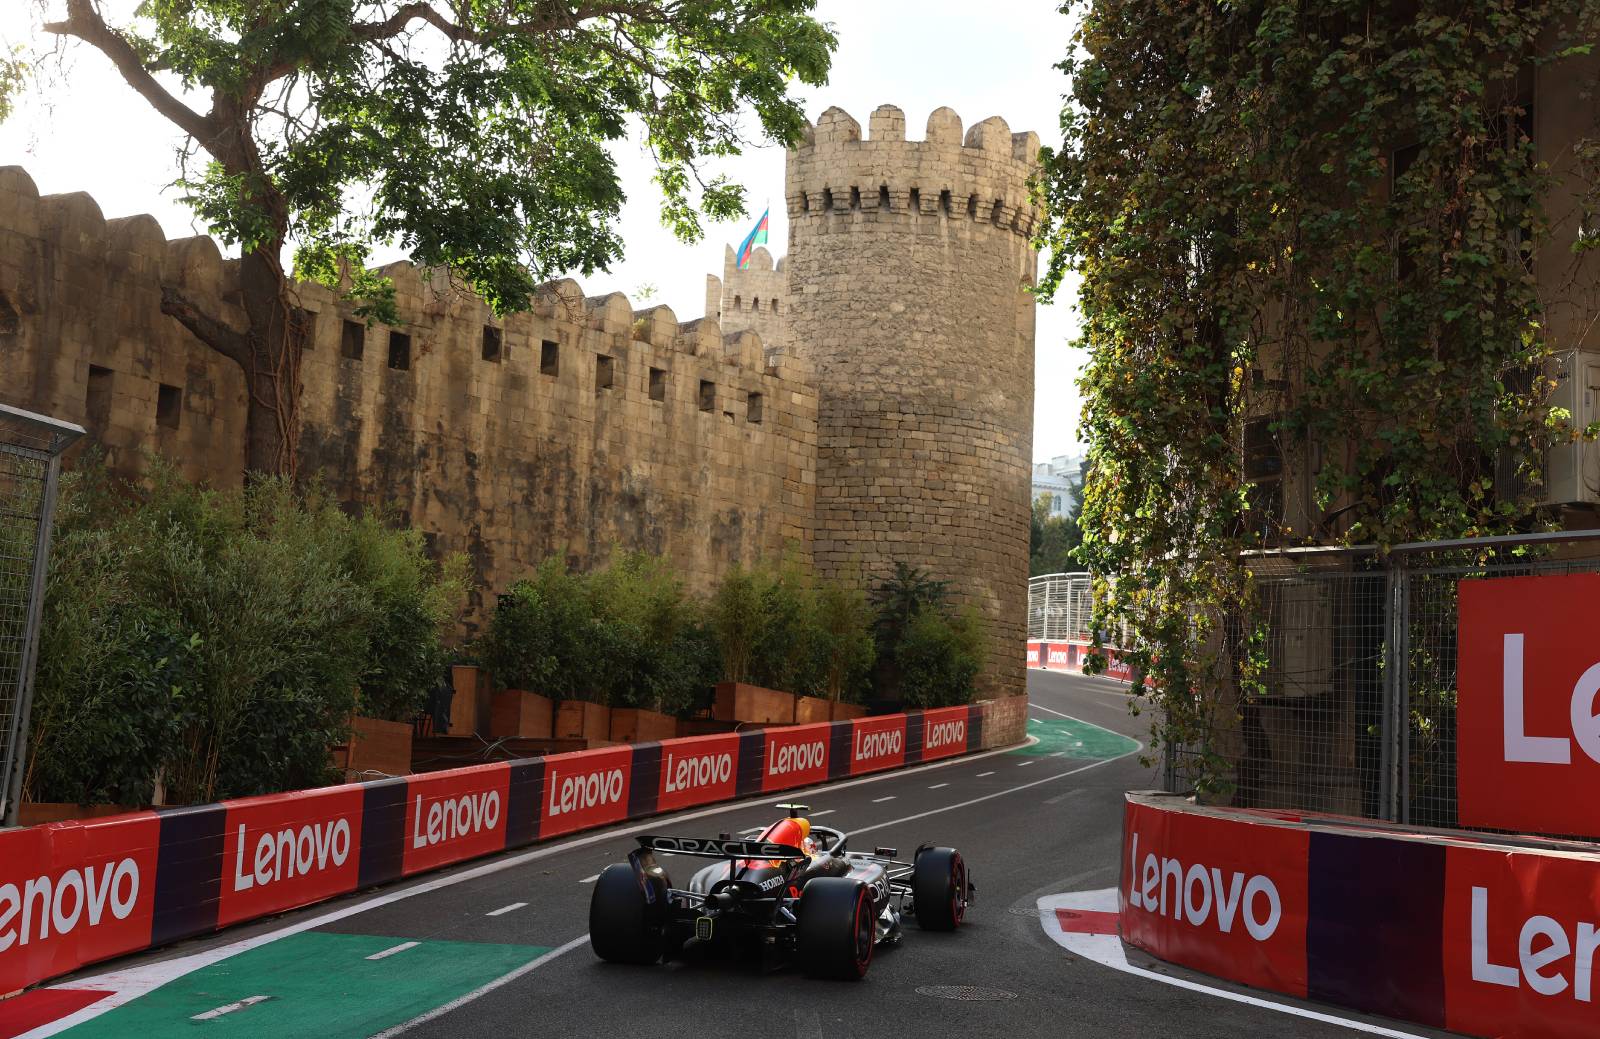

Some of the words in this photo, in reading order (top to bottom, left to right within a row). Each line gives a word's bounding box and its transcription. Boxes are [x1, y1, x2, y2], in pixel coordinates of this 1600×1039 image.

[856, 727, 902, 761] Lenovo
[925, 718, 965, 749] Lenovo
[665, 751, 732, 793] Lenovo
[768, 739, 825, 776] Lenovo
[548, 768, 623, 817] Lenovo
[413, 790, 500, 849] Lenovo
[234, 817, 351, 892] Lenovo
[652, 837, 781, 856] ORACLE
[759, 874, 785, 892] HONDA
[1130, 832, 1282, 941] Lenovo
